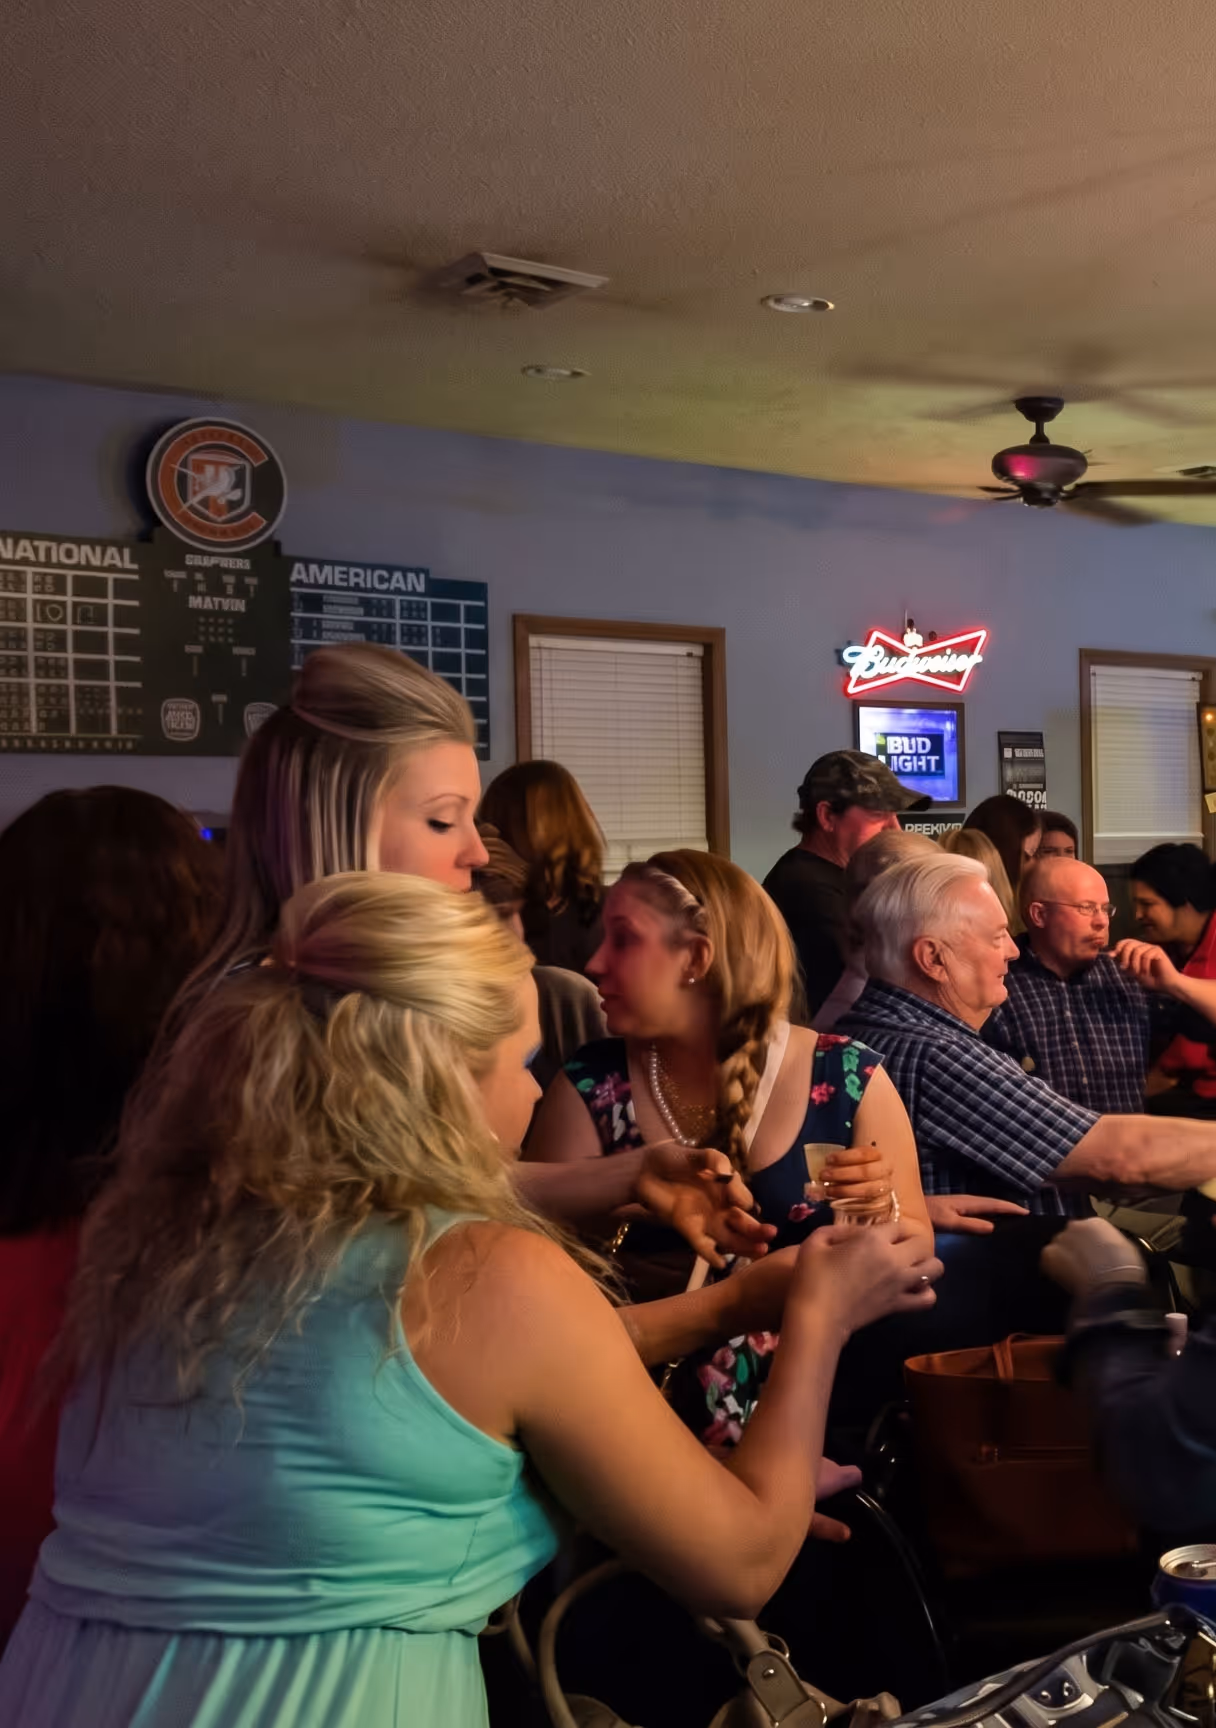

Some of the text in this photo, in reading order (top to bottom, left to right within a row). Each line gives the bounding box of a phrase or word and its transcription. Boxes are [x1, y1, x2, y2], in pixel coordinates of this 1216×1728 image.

[0, 537, 139, 570] NATIONAL
[290, 562, 426, 593] AMERICAN
[842, 644, 983, 679] Budweiser
[887, 736, 932, 755] BUD
